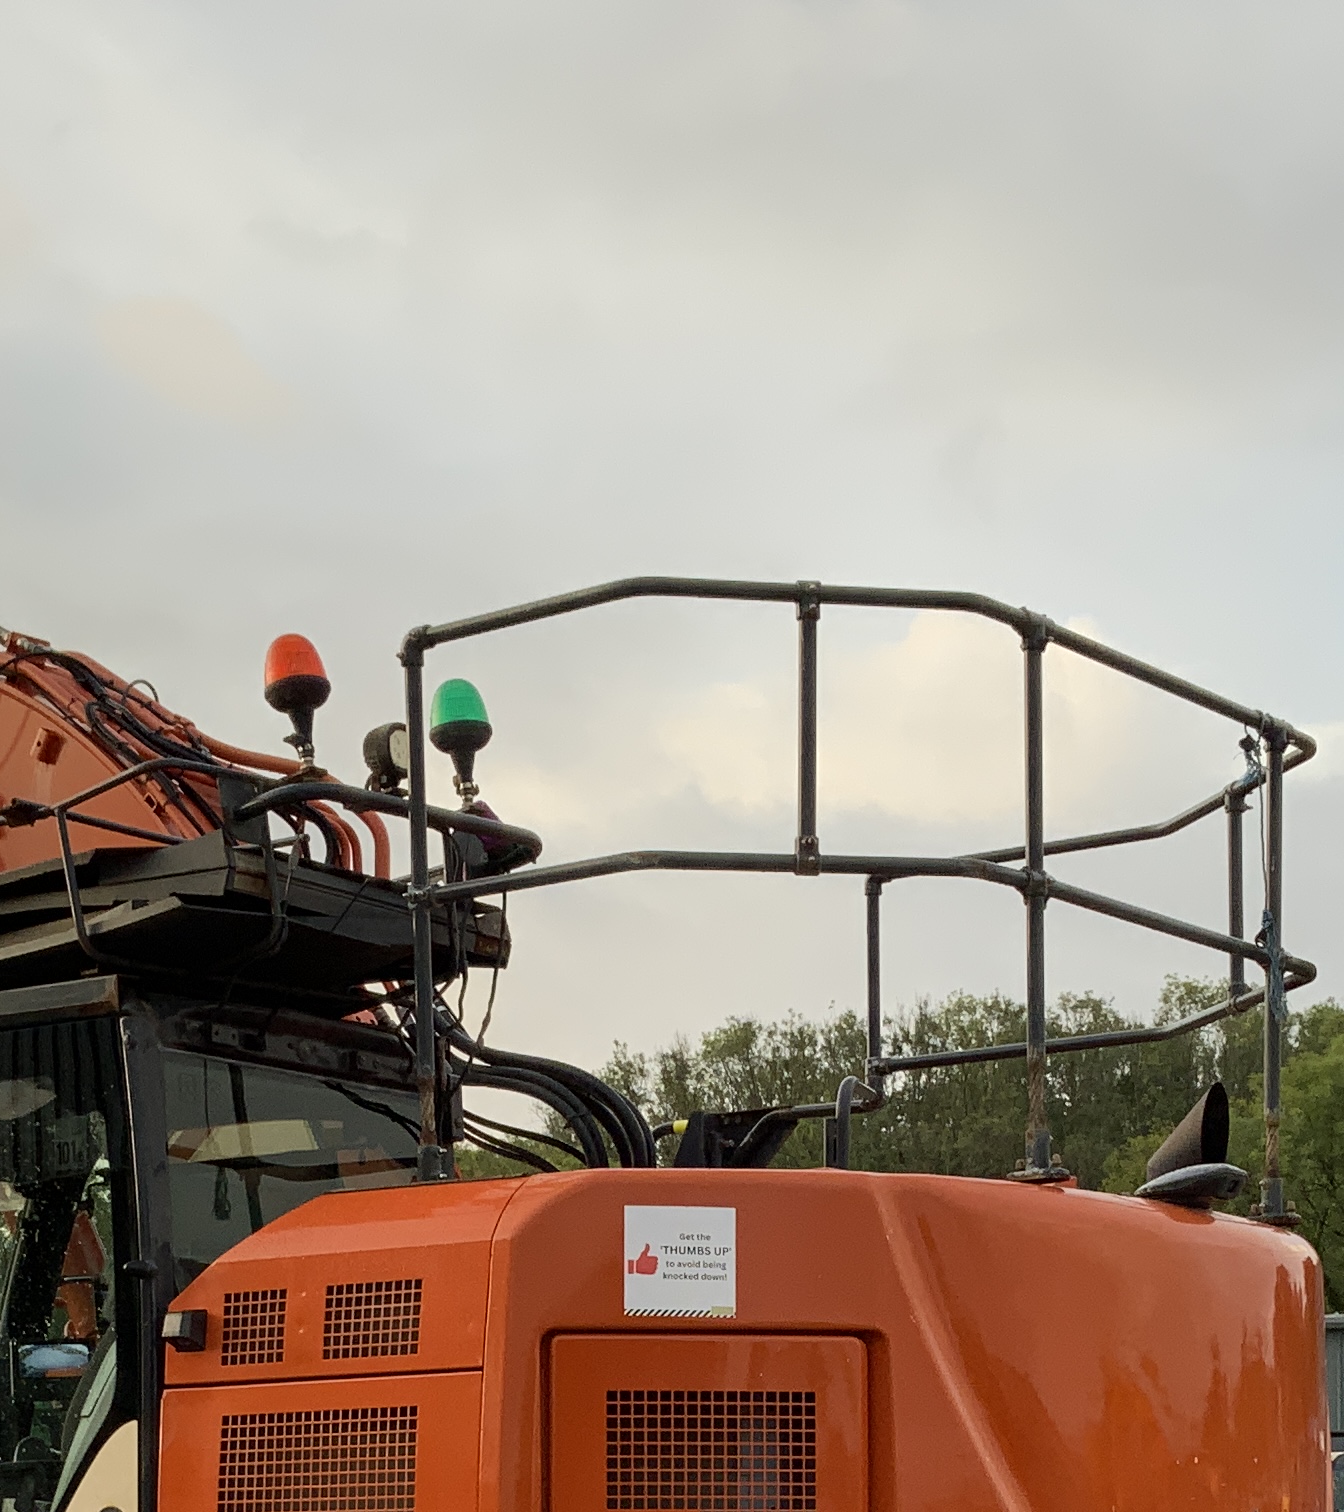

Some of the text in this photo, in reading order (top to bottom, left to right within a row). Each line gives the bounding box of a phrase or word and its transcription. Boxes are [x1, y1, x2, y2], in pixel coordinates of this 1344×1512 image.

[679, 1233, 711, 1241] Get the
[676, 1260, 701, 1268] avoid
[702, 1260, 727, 1271] being
[662, 1272, 727, 1281] knocked down!
